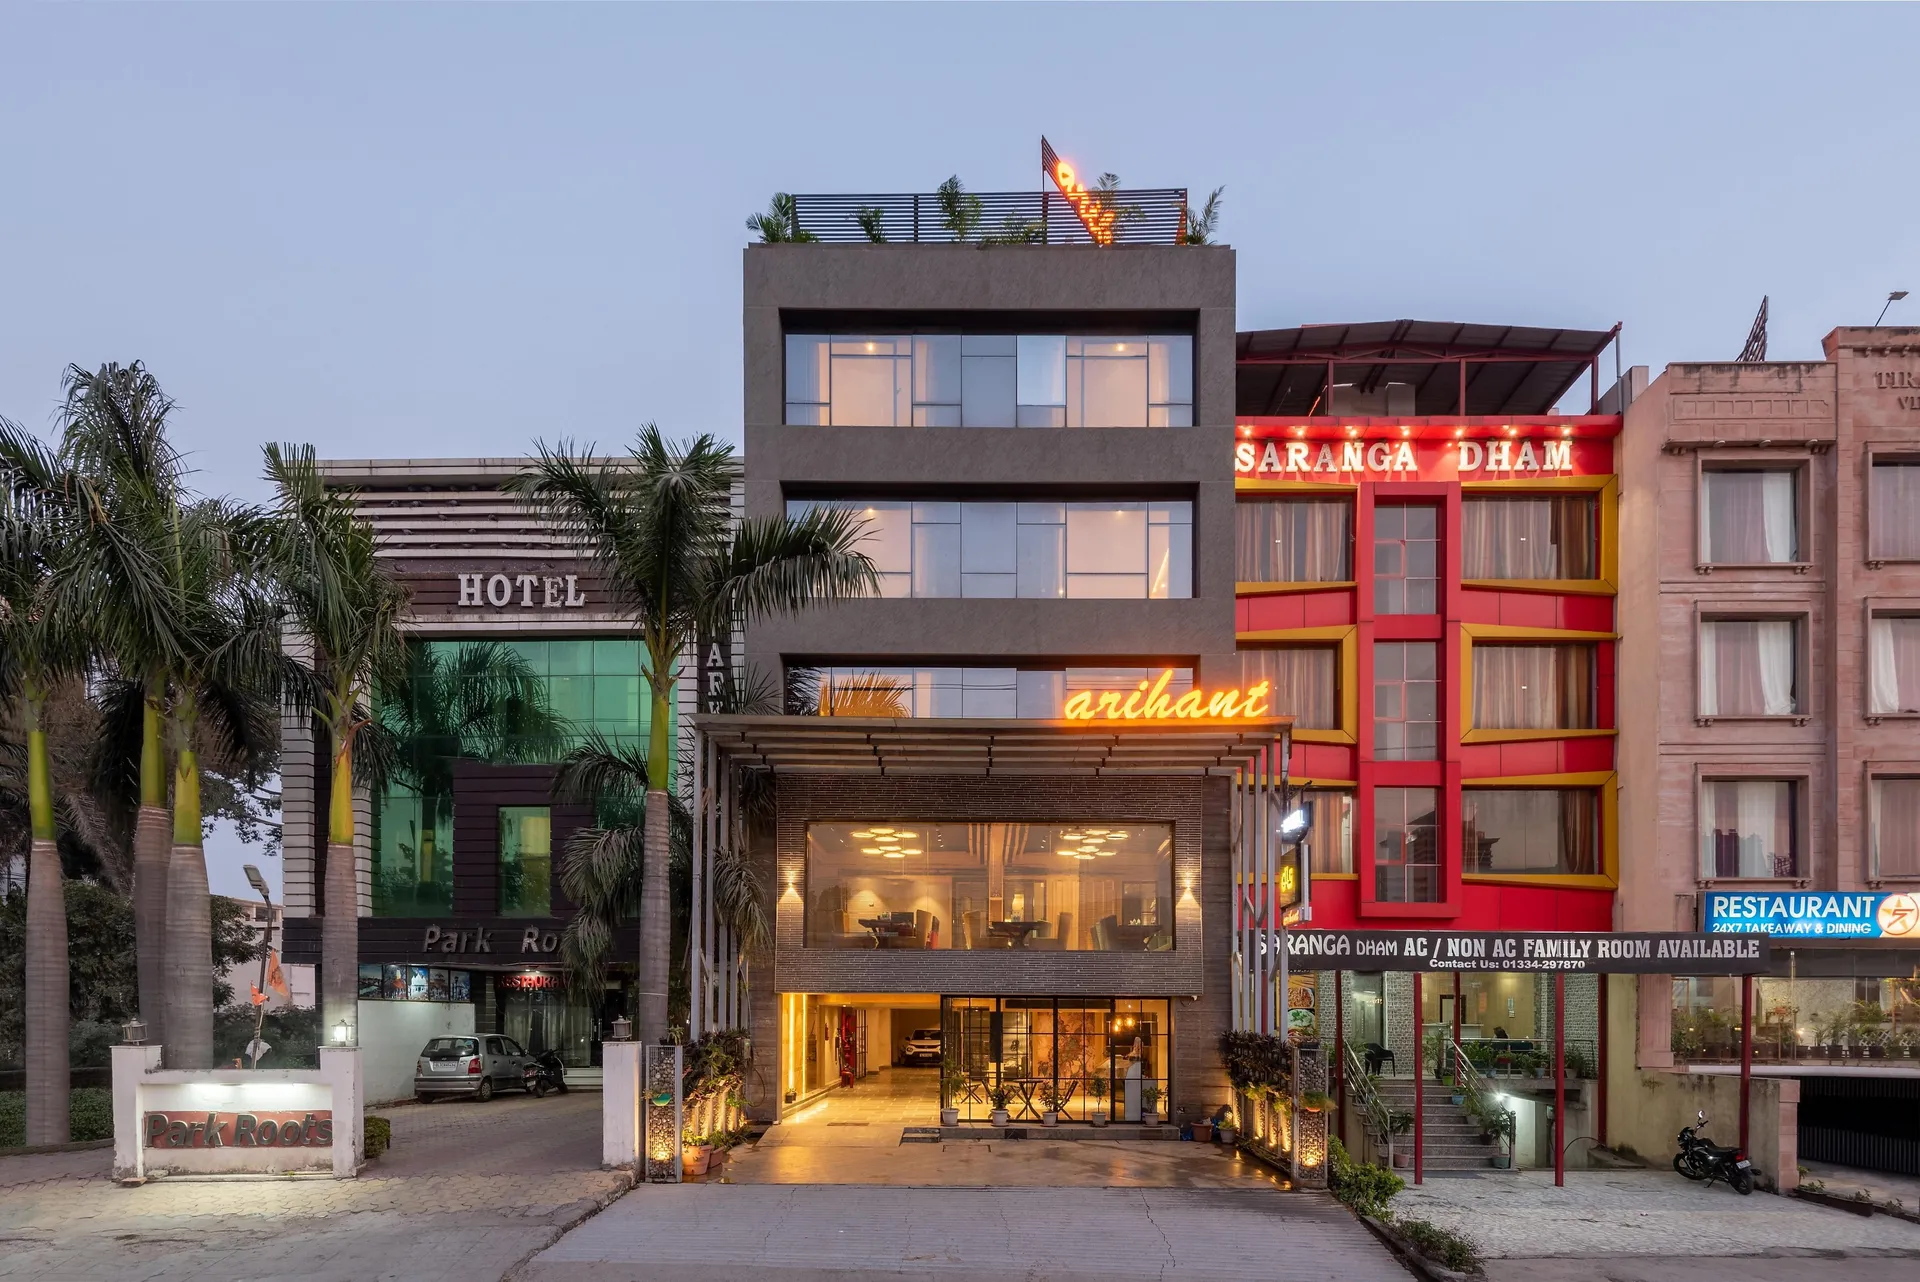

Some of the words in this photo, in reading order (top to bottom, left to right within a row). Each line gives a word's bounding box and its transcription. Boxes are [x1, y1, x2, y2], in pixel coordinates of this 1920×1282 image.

[1874, 370, 1920, 389] TIR
[1235, 440, 1418, 473] SARANGA
[1458, 440, 1573, 472] DHAM
[458, 574, 586, 608] HOTEL
[1064, 669, 1269, 720] arihant
[1713, 896, 1875, 918] RESTAURANT
[423, 925, 493, 953] Park
[521, 925, 558, 953] Ro
[1713, 923, 1741, 934] 24X7
[1746, 923, 1812, 934] TAKEAWAY
[1815, 923, 1823, 934] &
[1826, 923, 1872, 934] DINING
[1357, 939, 1397, 956] DHAM
[1403, 937, 1428, 957] AC
[1447, 938, 1486, 957] NON
[1492, 939, 1517, 958] AC
[1523, 939, 1592, 958] FAMILY
[1597, 940, 1651, 958] ROOM
[1657, 939, 1760, 958] AVAILABLE
[1429, 959, 1477, 969] Contact
[1480, 960, 1499, 969] Us:
[1502, 960, 1586, 970] 01334-297870
[145, 1112, 228, 1148] Park
[233, 1112, 332, 1147] Roots
